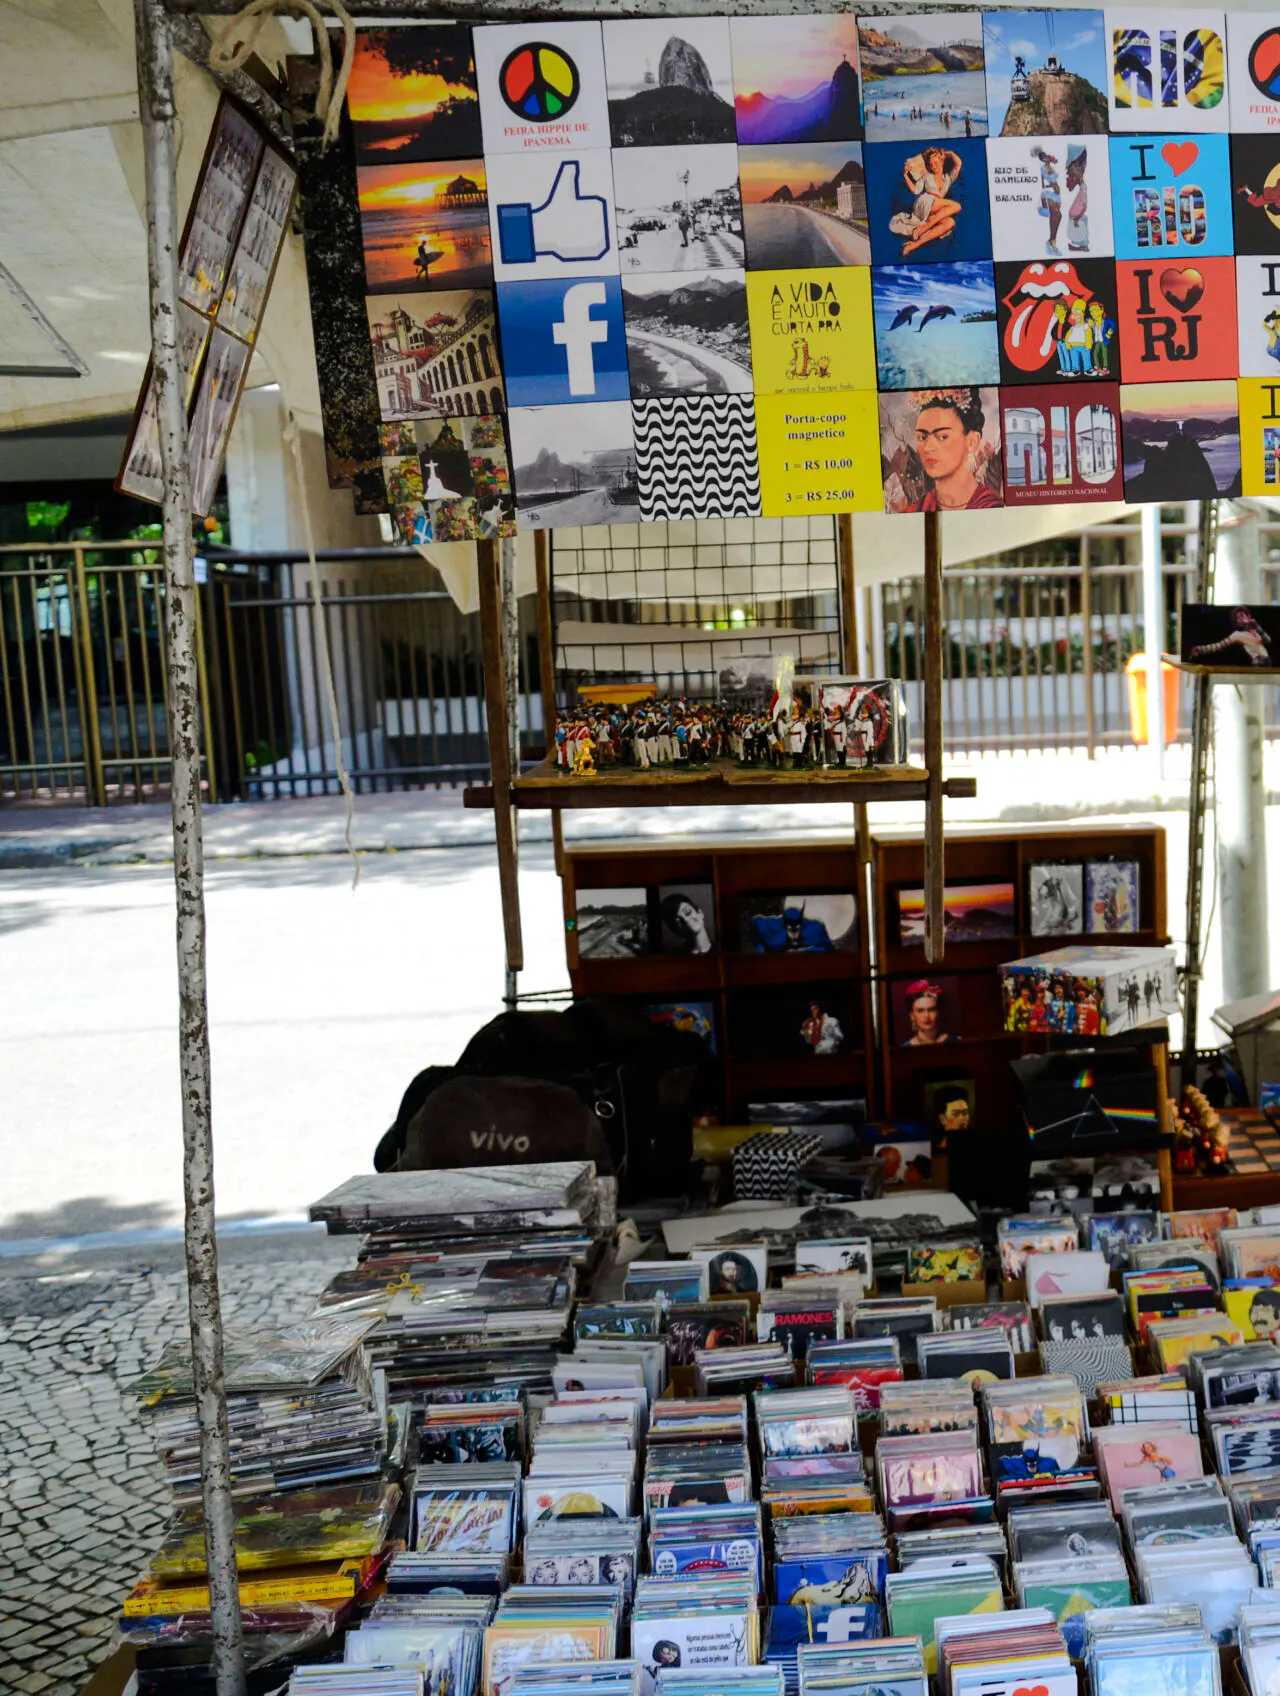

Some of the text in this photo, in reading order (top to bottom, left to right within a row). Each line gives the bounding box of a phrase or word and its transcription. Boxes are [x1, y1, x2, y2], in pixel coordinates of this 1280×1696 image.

[1112, 28, 1224, 109] RIO
[1249, 104, 1278, 113] FEIRA
[504, 122, 588, 136] FEIRA HIPPIE DE
[523, 136, 571, 147] IPANEMA
[1129, 144, 1156, 181] I
[994, 167, 1012, 175] RIO
[995, 194, 1032, 202] BRASIL
[1133, 184, 1207, 247] RIO
[771, 282, 837, 304] A VIDA
[1133, 269, 1156, 314] I
[772, 301, 840, 320] É MUITO
[772, 319, 842, 335] CURTA PRA
[1138, 315, 1202, 362] RJ
[784, 414, 846, 424] Porta-copo
[787, 428, 845, 441] magnetico
[1004, 404, 1117, 486] RIO
[784, 462, 788, 471] 1
[824, 458, 853, 470] 10,00
[785, 493, 792, 502] 3
[826, 489, 855, 500] 25,00
[1075, 487, 1107, 495] NACIONAL
[470, 1124, 530, 1153] vivo
[775, 1312, 833, 1325] RAMONES
